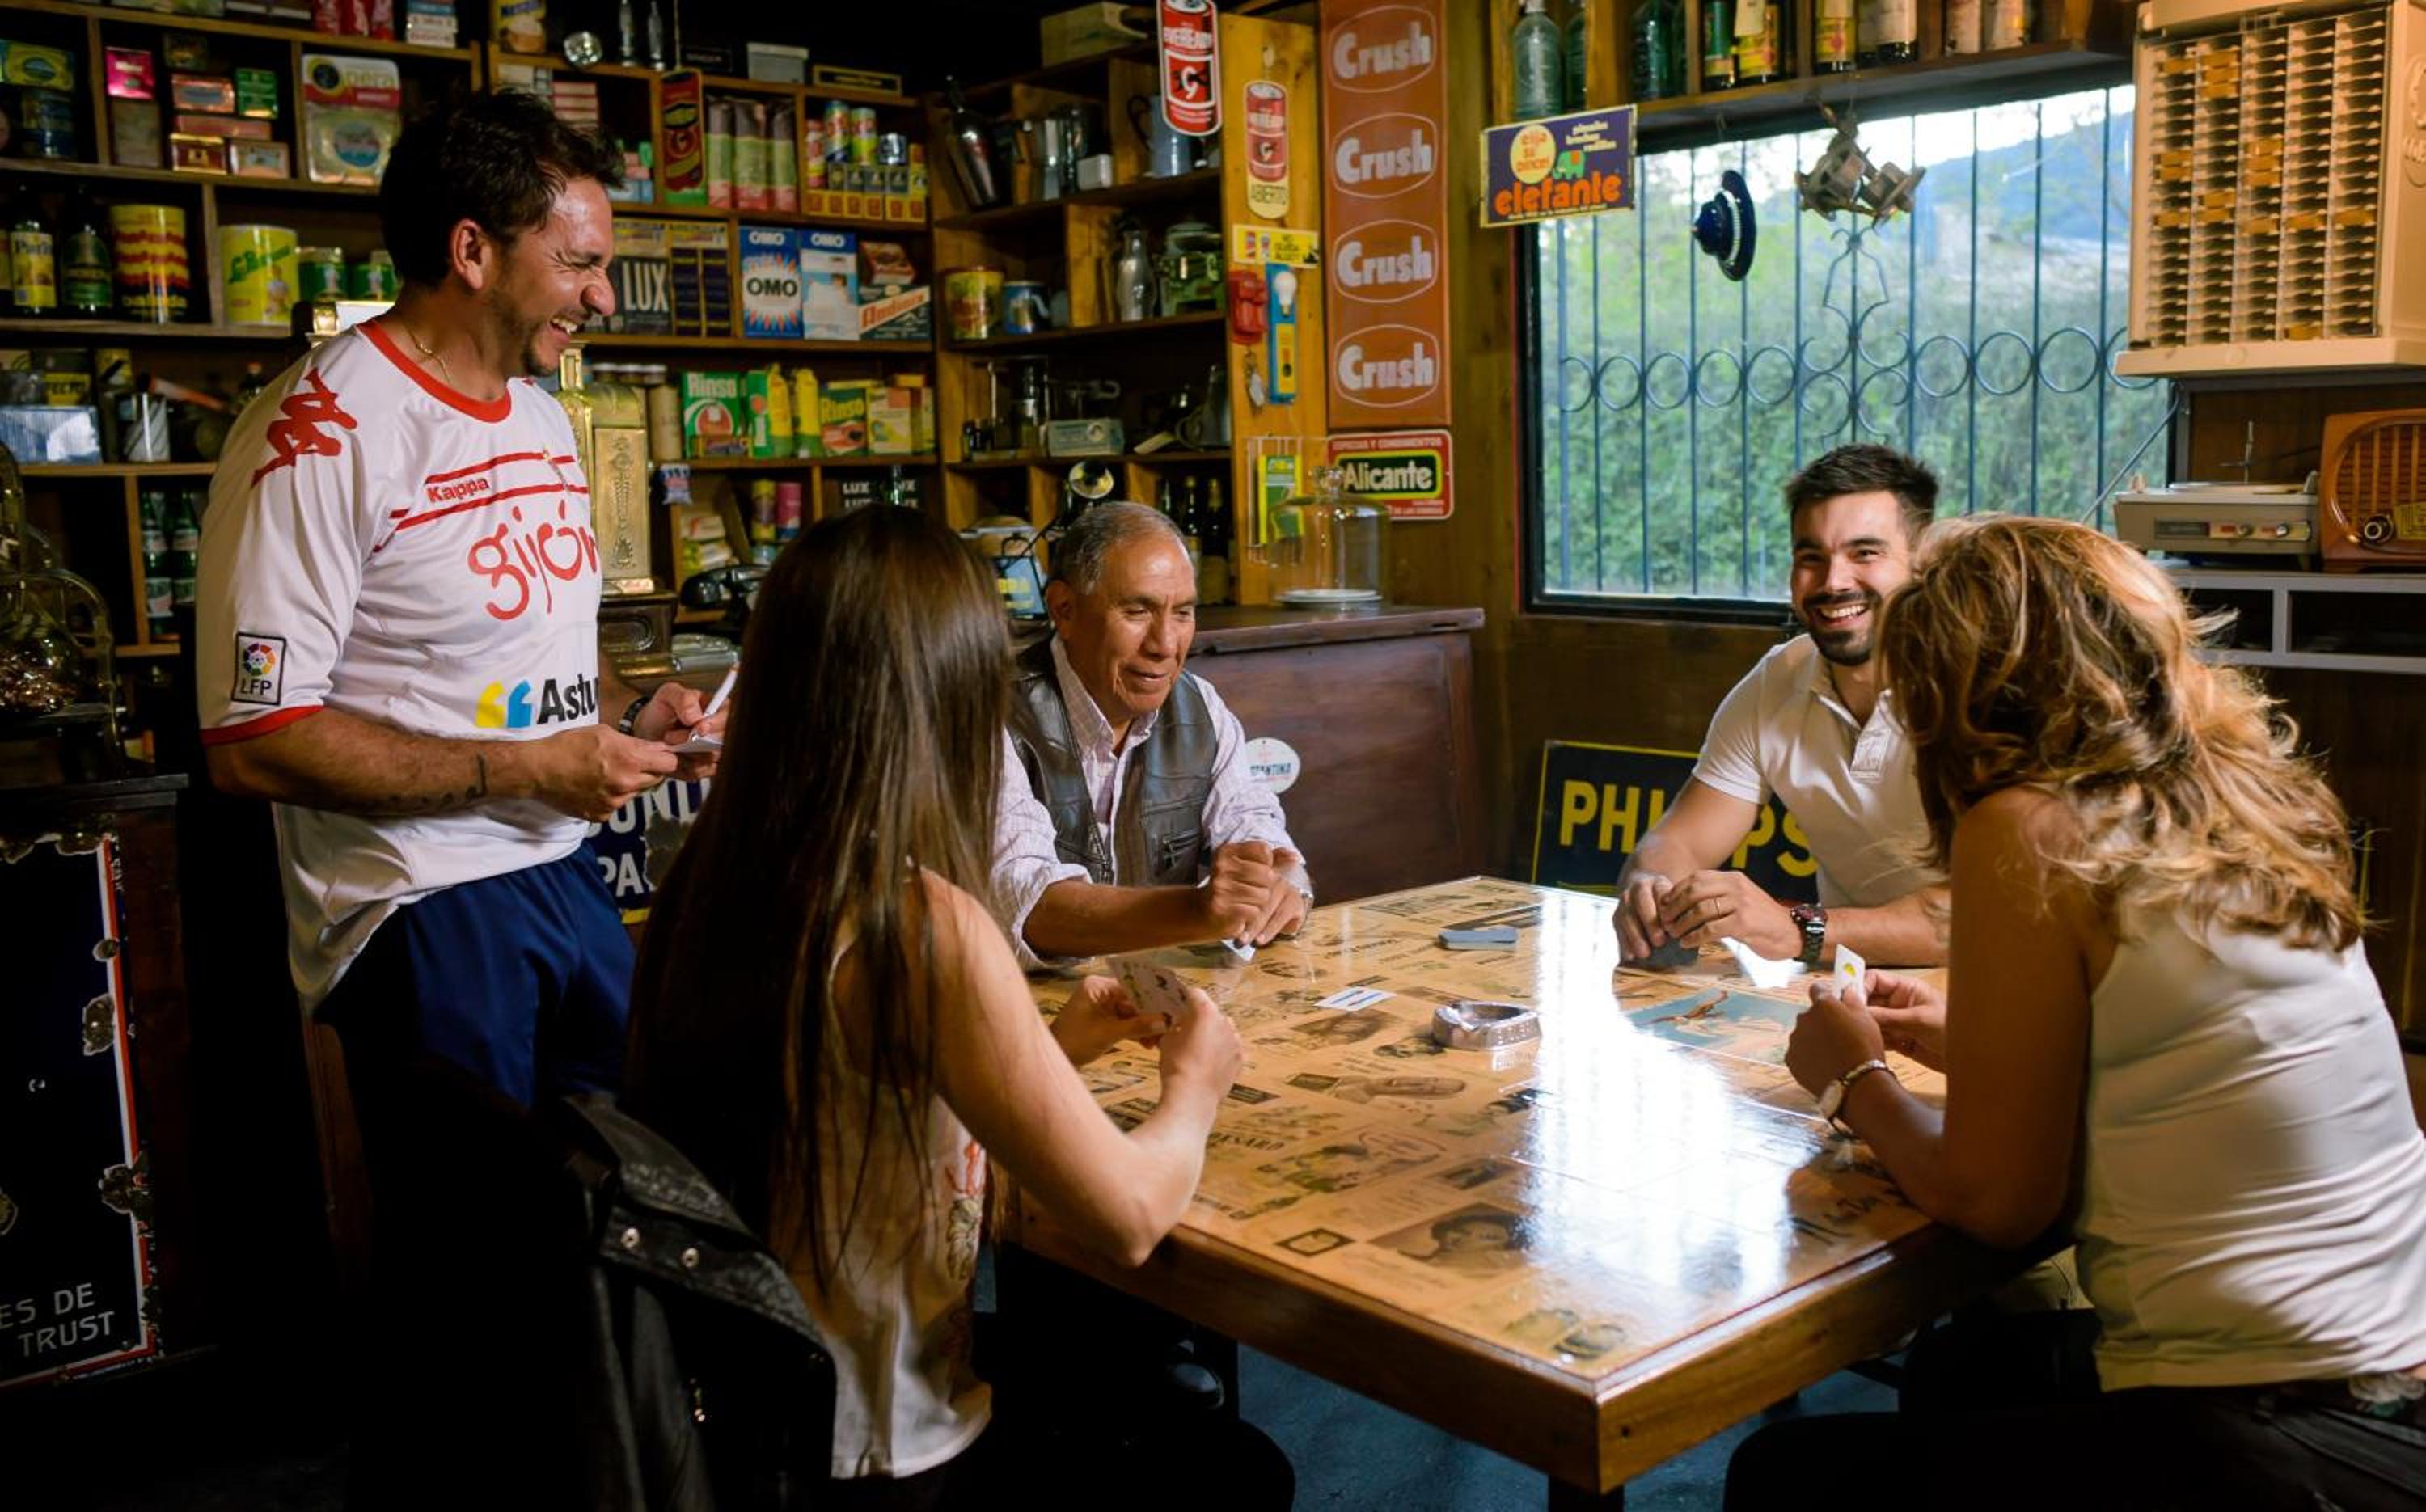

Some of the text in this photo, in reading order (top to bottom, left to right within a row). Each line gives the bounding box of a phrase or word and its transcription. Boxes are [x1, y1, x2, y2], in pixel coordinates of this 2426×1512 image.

[1333, 21, 1431, 79] Crush
[1336, 129, 1432, 184] Crush
[1495, 171, 1622, 217] elefante
[749, 230, 785, 245] OMO
[810, 233, 845, 247] OMO
[1337, 235, 1433, 287] Crush
[622, 260, 669, 312] LUX
[747, 277, 798, 298] OMO
[1339, 342, 1435, 390] Crush
[689, 372, 737, 398] Rinso
[821, 398, 864, 423] Rinso
[426, 475, 489, 503] Kappa
[843, 481, 869, 495] LUX
[1342, 459, 1433, 491] Alicante
[240, 680, 273, 695] LFP
[1559, 779, 1820, 877] PHIPS
[54, 1282, 95, 1315] DE
[18, 1311, 115, 1357] TRUST
